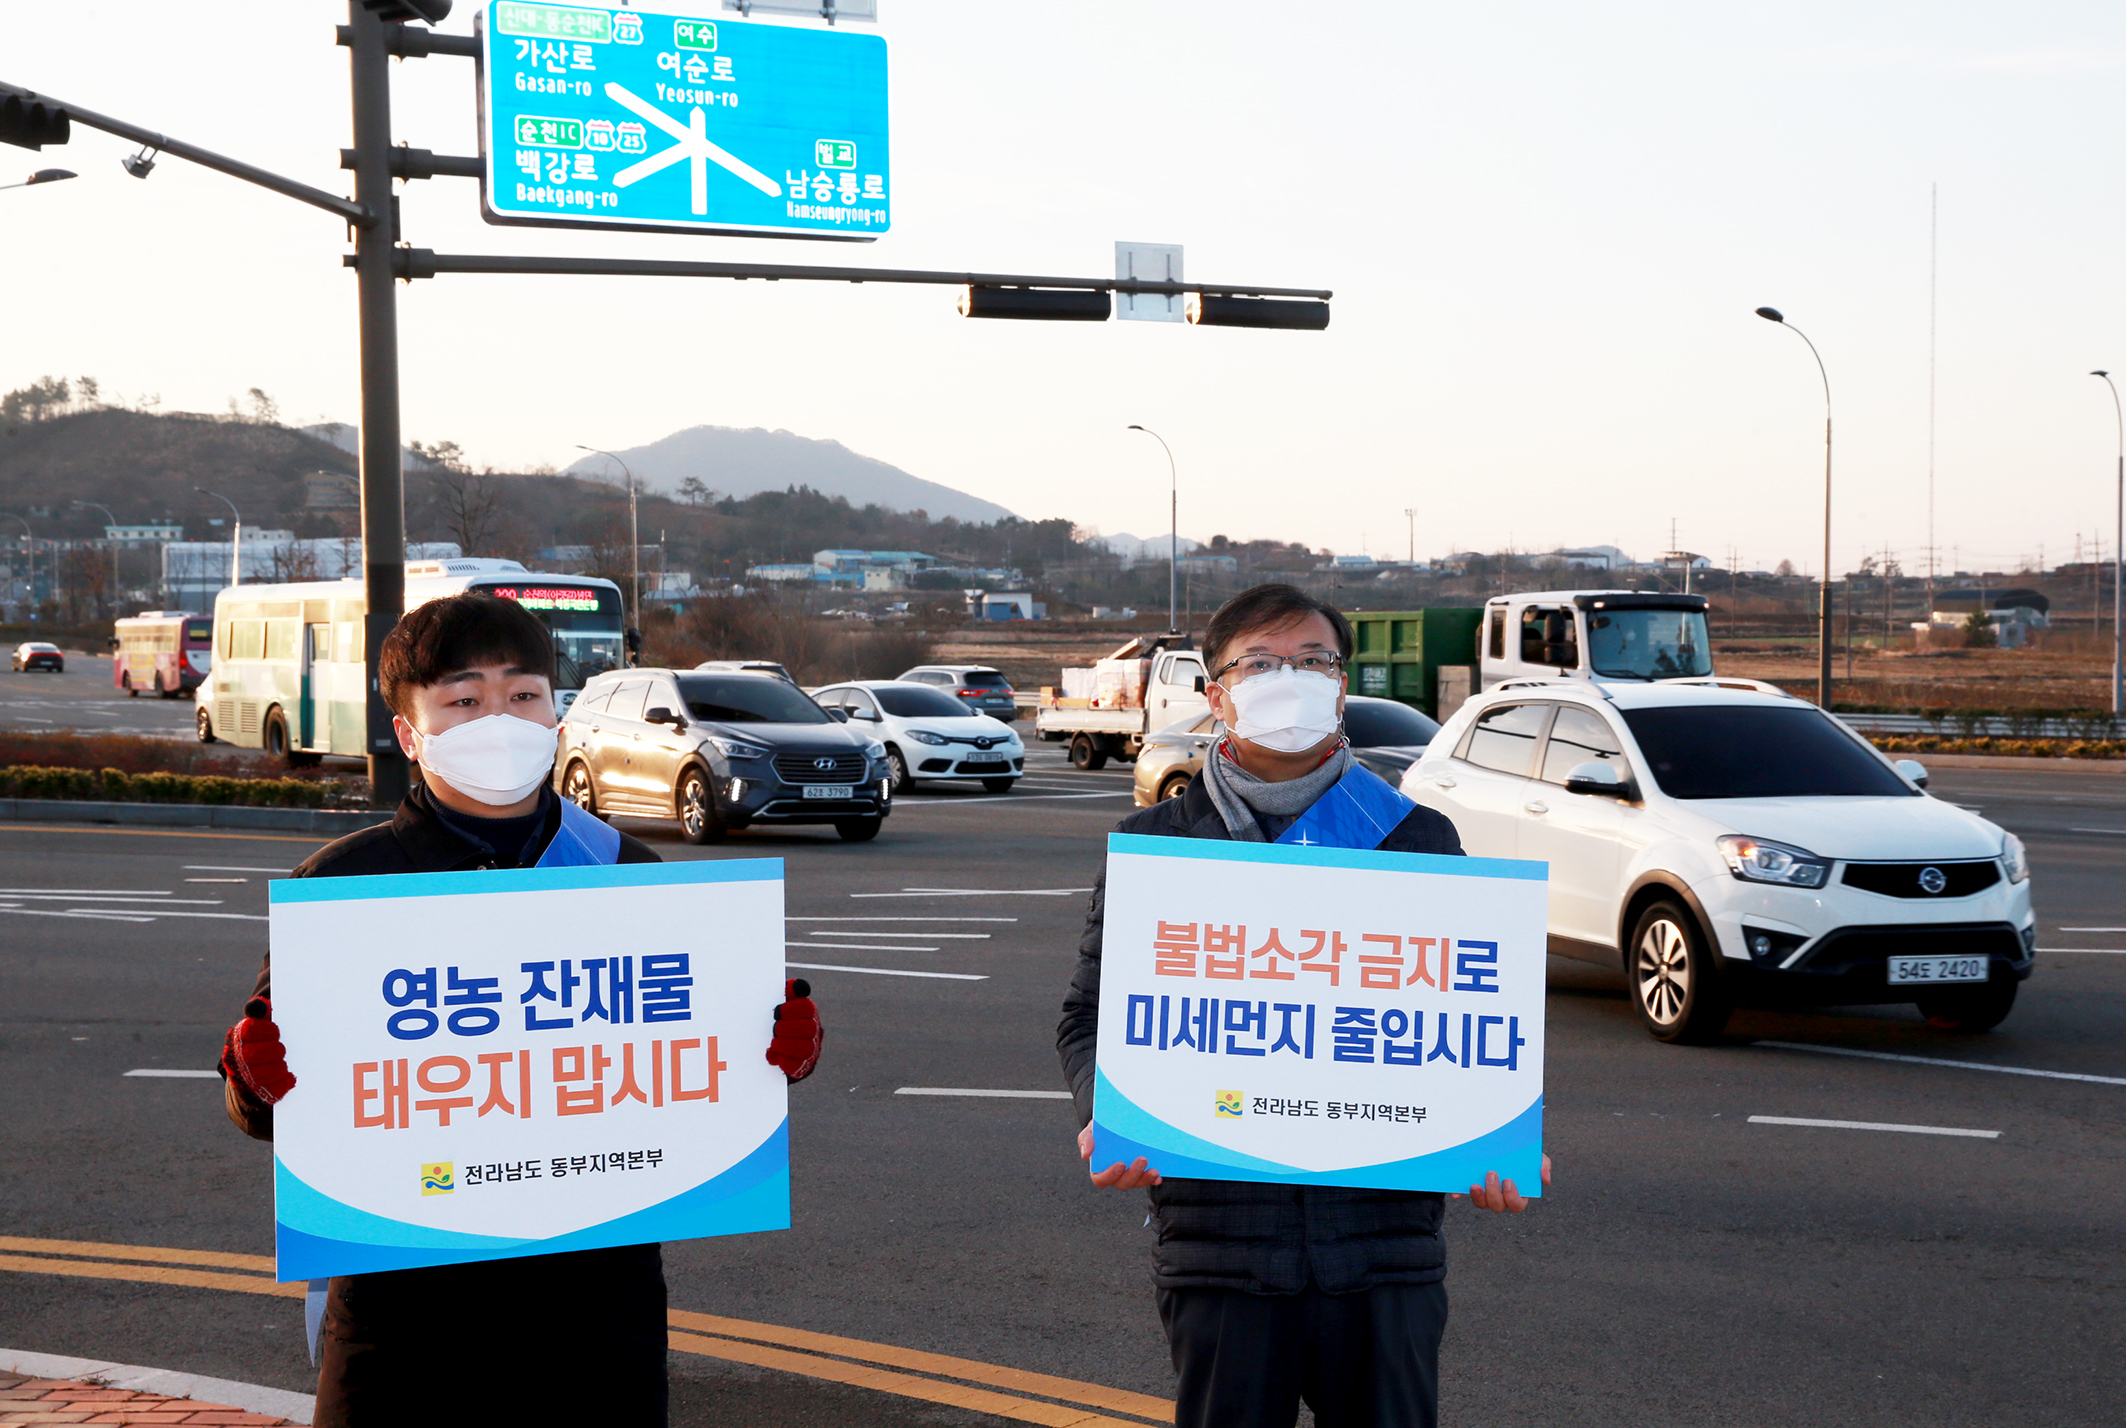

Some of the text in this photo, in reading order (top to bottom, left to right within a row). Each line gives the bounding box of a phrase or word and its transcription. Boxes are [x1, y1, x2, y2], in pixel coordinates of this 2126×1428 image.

[620, 25, 637, 39] 27
[678, 24, 714, 45] 여수
[514, 39, 597, 74] 가산로
[656, 51, 736, 84] 여순로
[515, 71, 592, 97] Gasan-ro
[655, 82, 738, 108] Yeosun-ro
[520, 120, 577, 144] 순천IC
[593, 132, 608, 145] 10
[623, 134, 640, 148] 25
[516, 149, 599, 185] 백강로
[819, 143, 853, 165] 벌교
[516, 182, 618, 209] Baekgang-ro
[786, 169, 886, 206] 남승룡로
[786, 200, 886, 226] Namseungryong-ro
[827, 787, 849, 797] 3790
[1153, 920, 1500, 994] 불법소각 금지로
[1938, 960, 1980, 979] 2420
[382, 952, 694, 1041] 영농 잔재물
[1125, 993, 1526, 1072] 미세먼지 줄입시다
[353, 1035, 727, 1130] 태우지 맙시다
[1252, 1097, 1428, 1124] 전라남도 동부지역본부
[465, 1148, 664, 1186] 전라남도 동부지역본부
